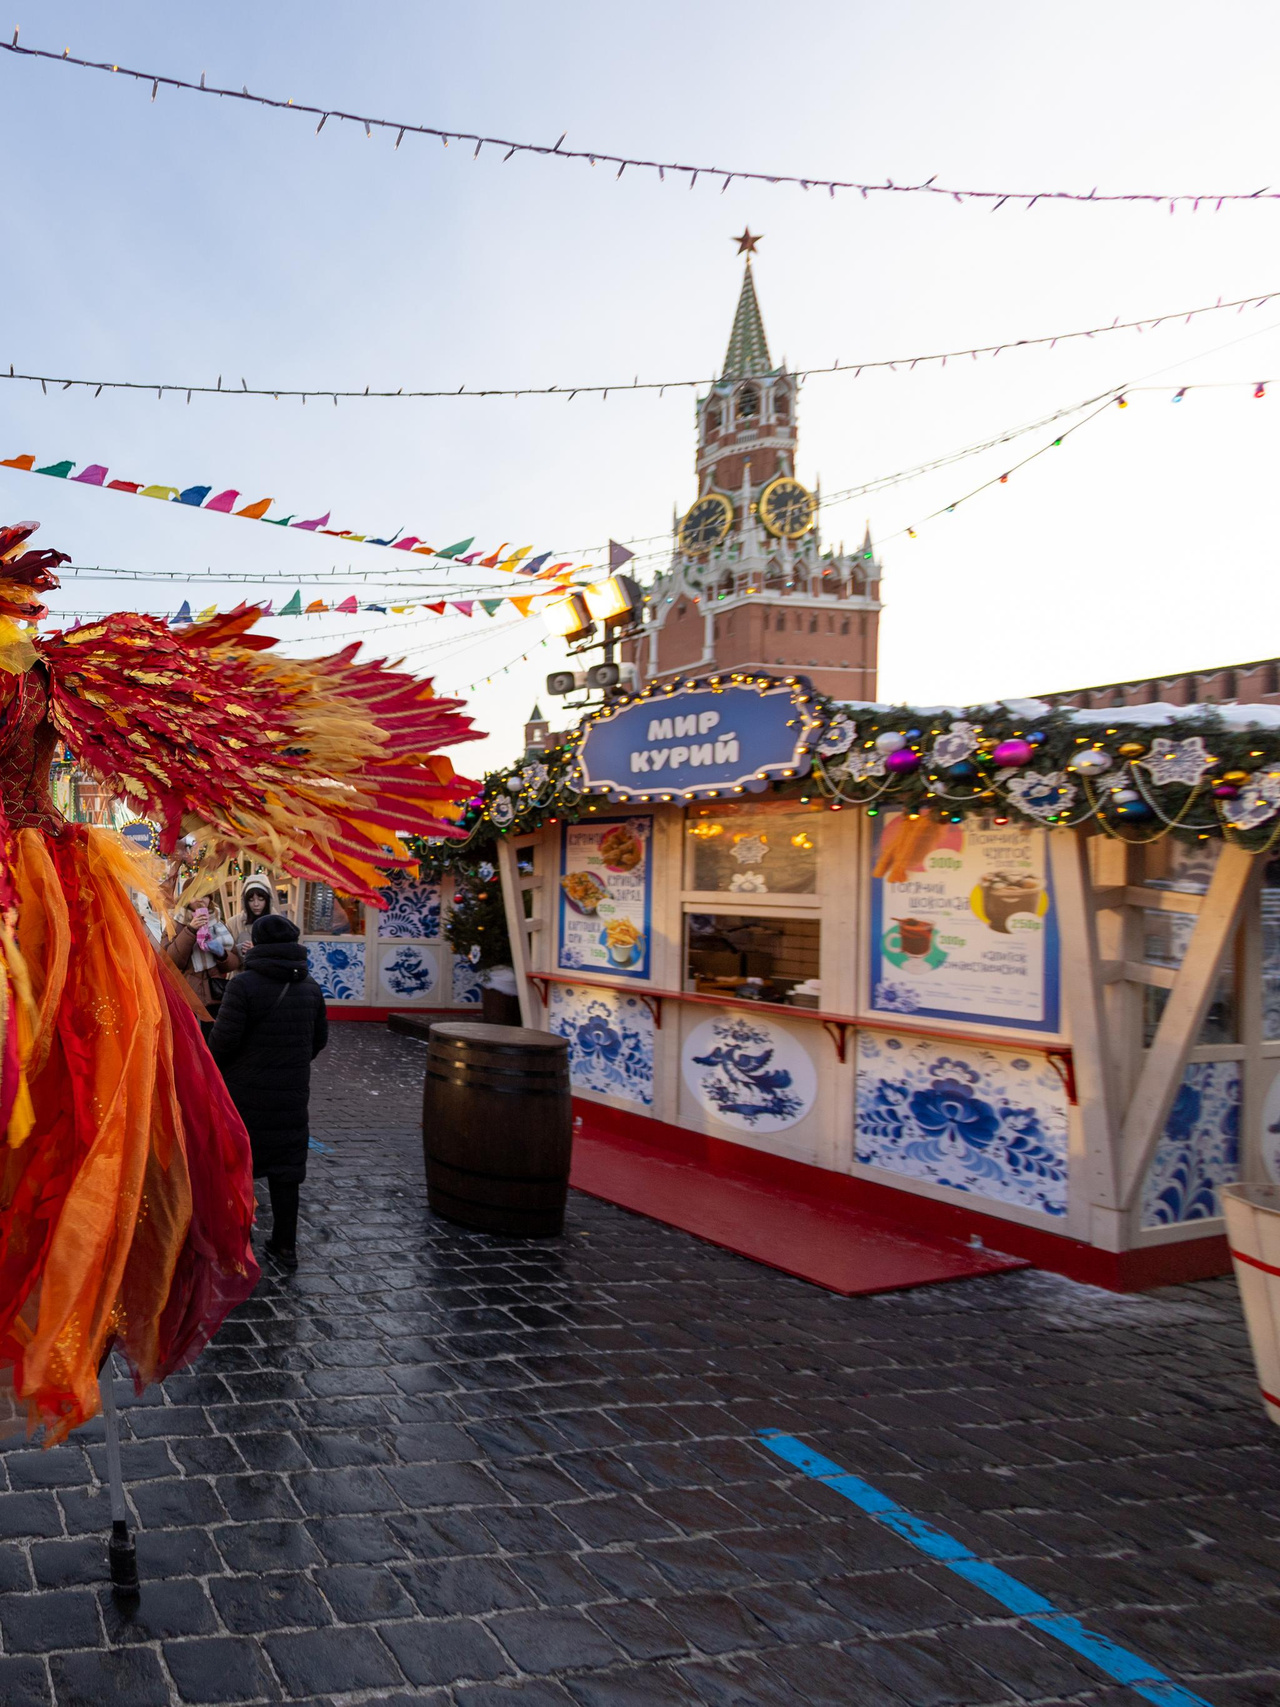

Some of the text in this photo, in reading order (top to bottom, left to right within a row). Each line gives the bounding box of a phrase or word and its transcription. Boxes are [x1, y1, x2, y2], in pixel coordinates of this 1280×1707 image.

[647, 710, 720, 742] МИР
[630, 731, 739, 773] КУРИЙ
[929, 857, 962, 871] 300р
